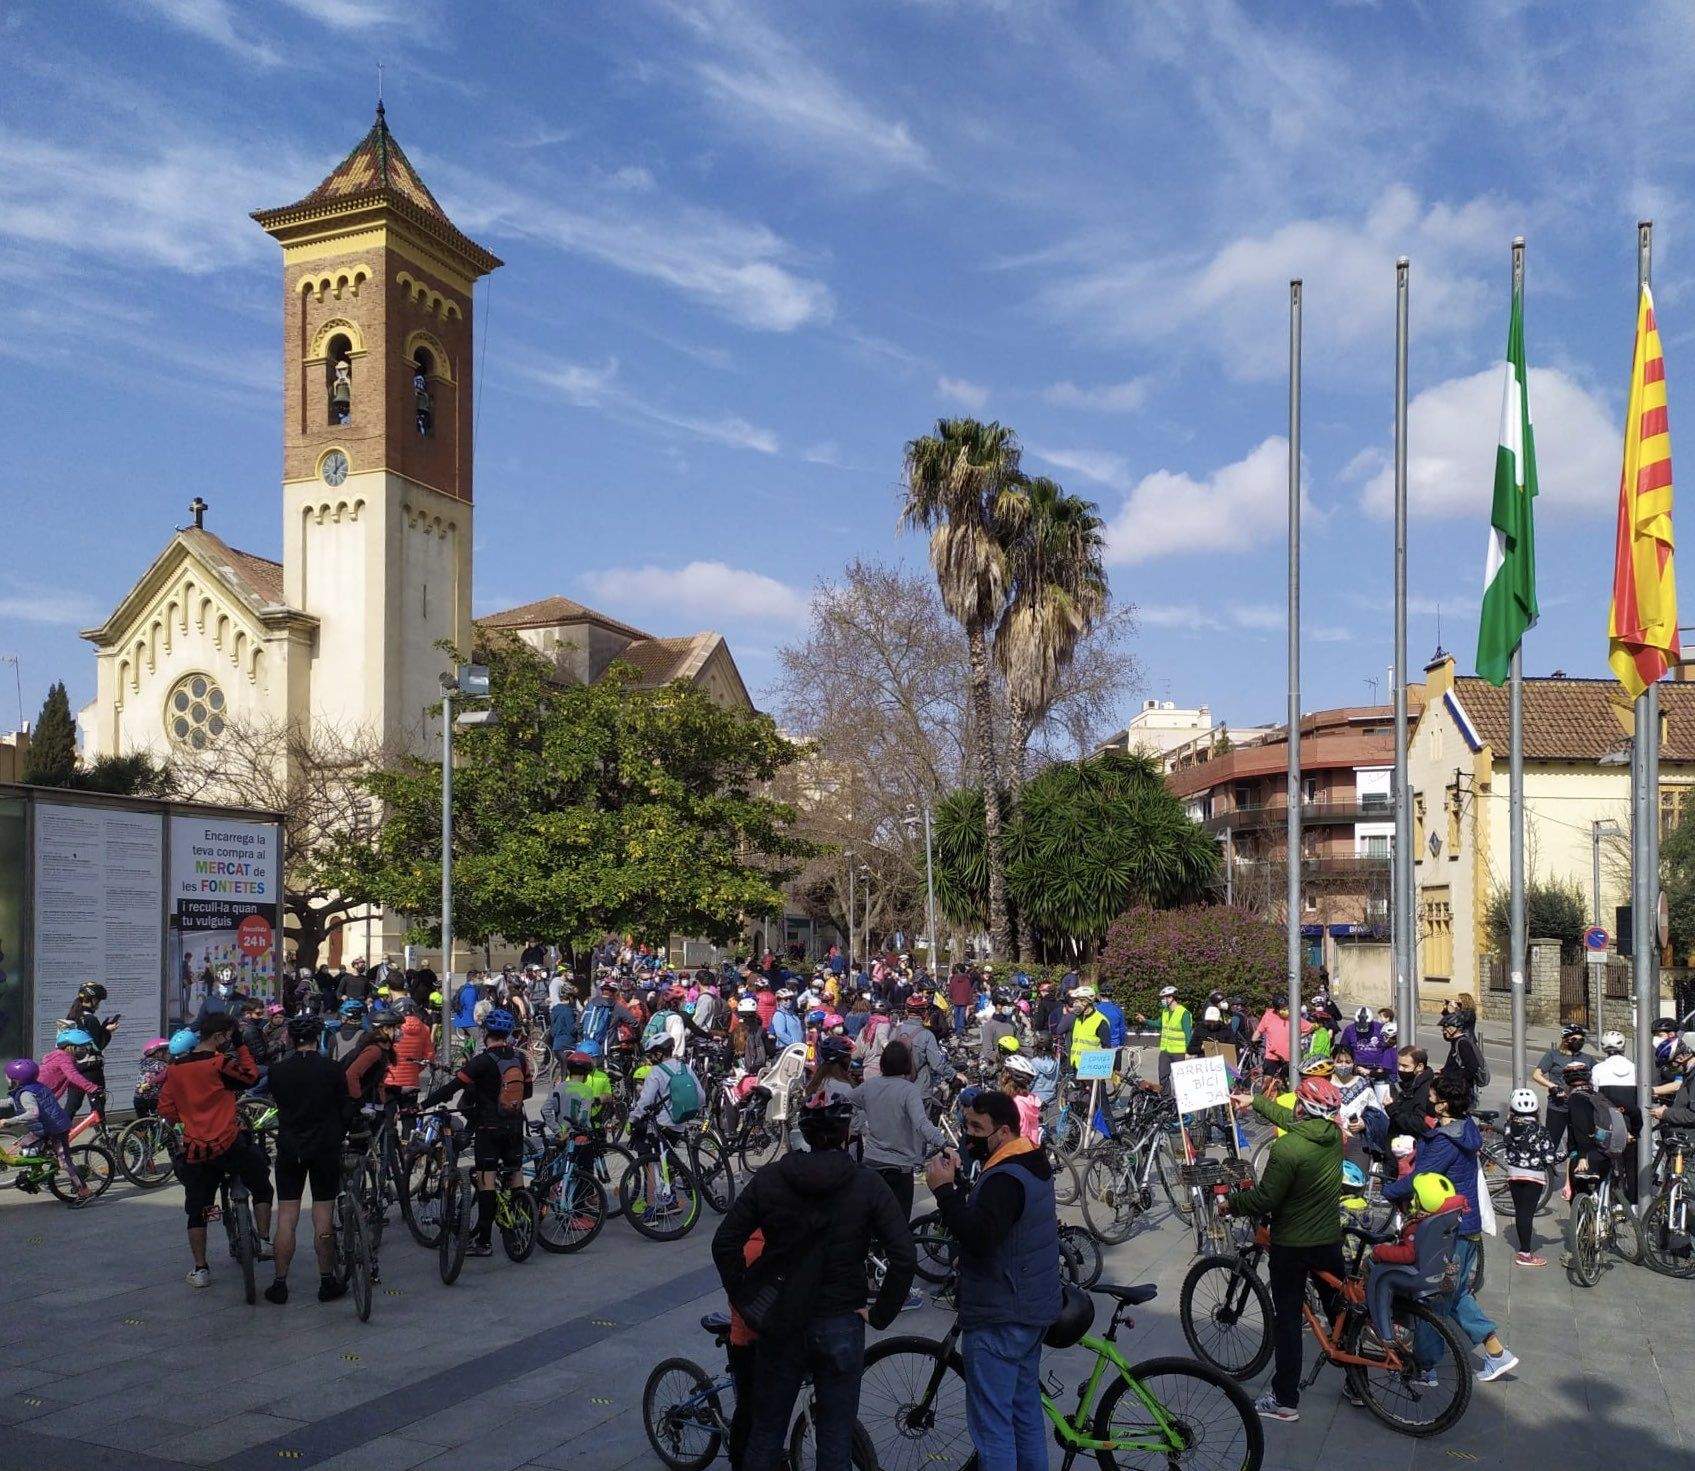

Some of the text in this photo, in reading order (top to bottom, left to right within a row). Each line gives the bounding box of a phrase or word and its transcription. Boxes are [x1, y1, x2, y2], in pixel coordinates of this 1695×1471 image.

[204, 829, 265, 845] Encarrega la
[193, 844, 265, 860] teva compra al
[195, 860, 265, 877] MERCAT de
[182, 880, 265, 894] les FONTETES
[189, 901, 230, 914] recull-la
[232, 904, 258, 915] quan
[182, 915, 232, 929] tu vulguis
[243, 936, 258, 948] 24
